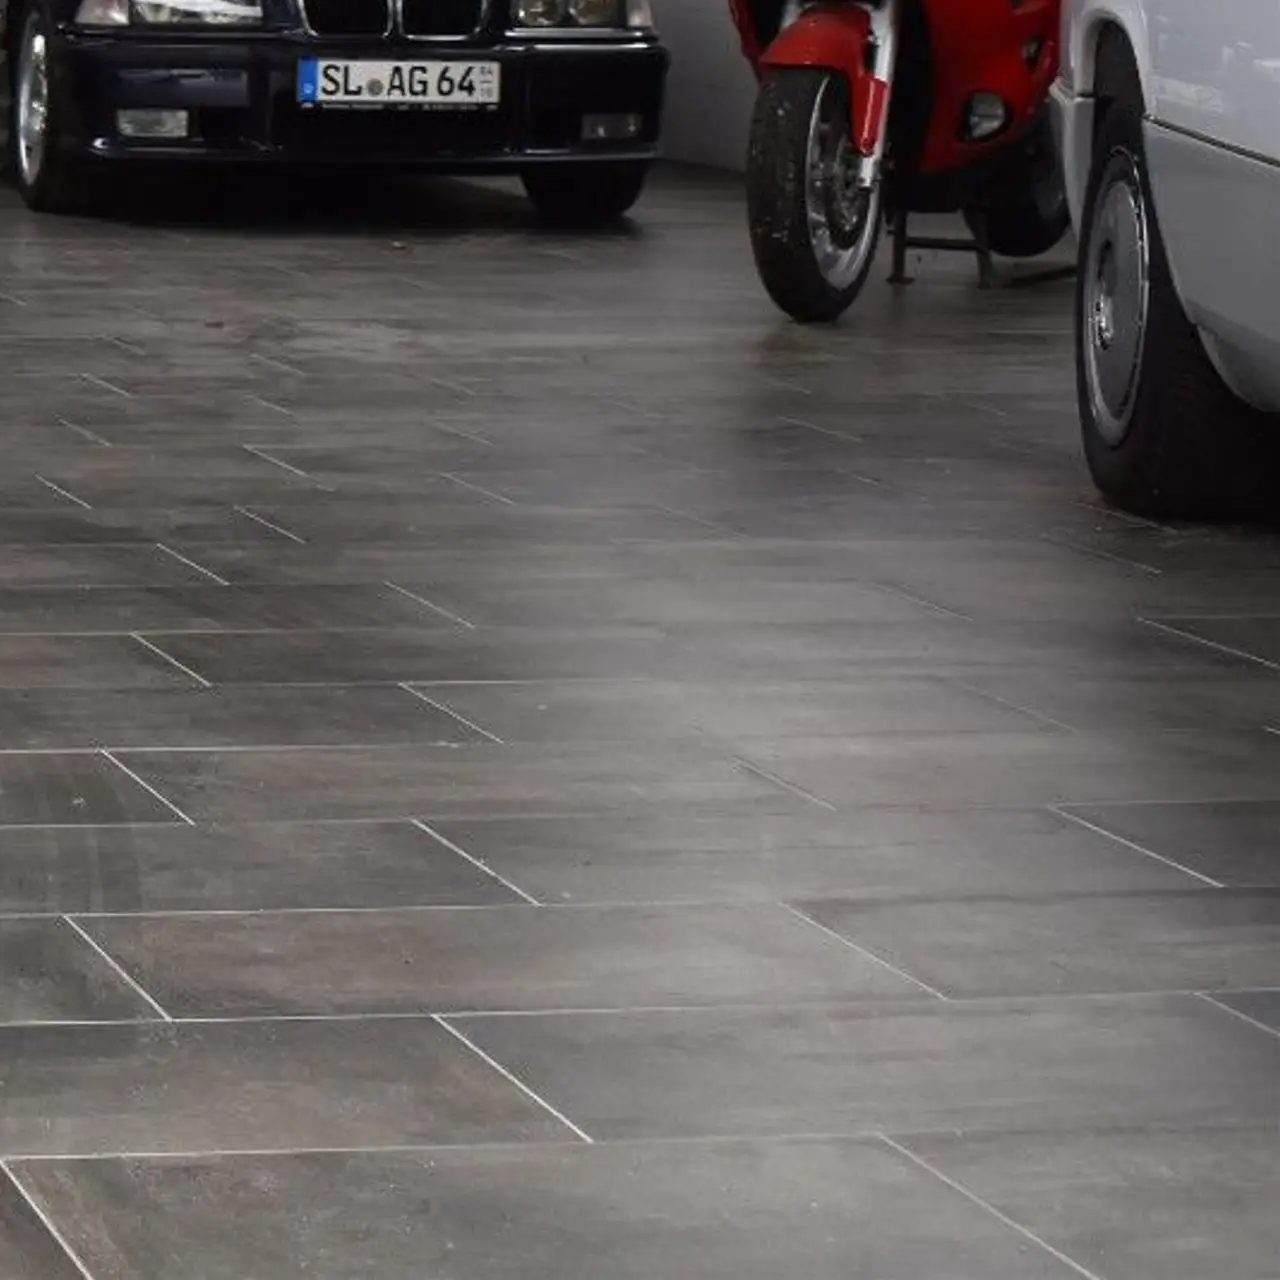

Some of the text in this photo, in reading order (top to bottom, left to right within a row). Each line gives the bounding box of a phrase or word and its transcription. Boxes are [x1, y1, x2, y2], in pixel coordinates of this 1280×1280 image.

[322, 64, 476, 97] SL AG 64
